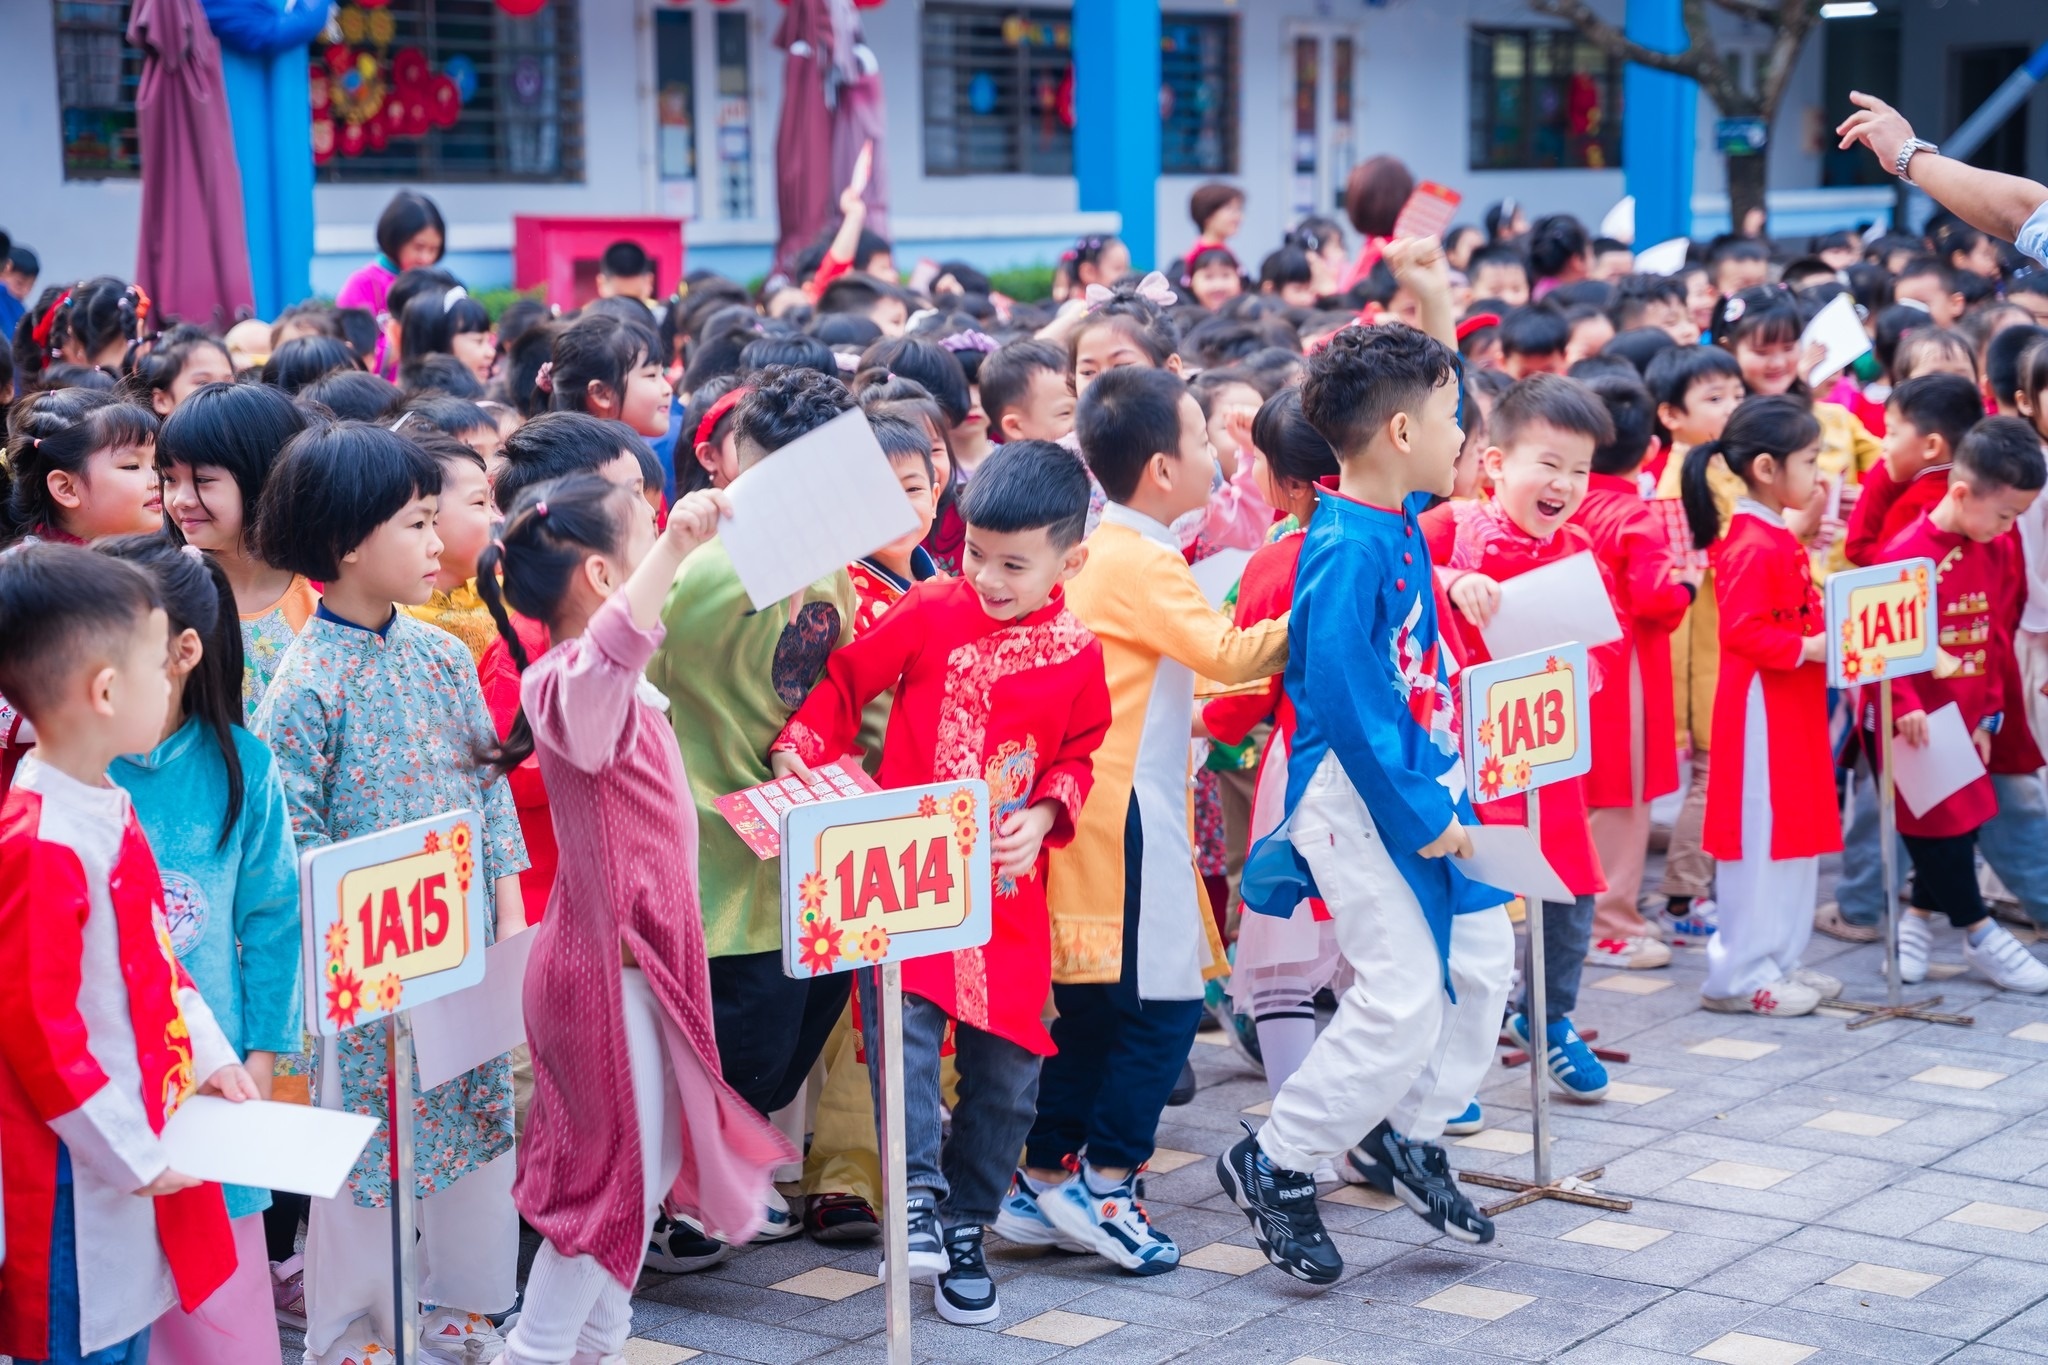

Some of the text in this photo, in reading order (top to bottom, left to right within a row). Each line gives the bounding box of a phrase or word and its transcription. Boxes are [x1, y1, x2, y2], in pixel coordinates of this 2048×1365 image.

[1859, 595, 1917, 650] 1A11
[1498, 689, 1565, 757] 1A13
[835, 836, 954, 922] 1A14
[358, 872, 449, 969] 1A15
